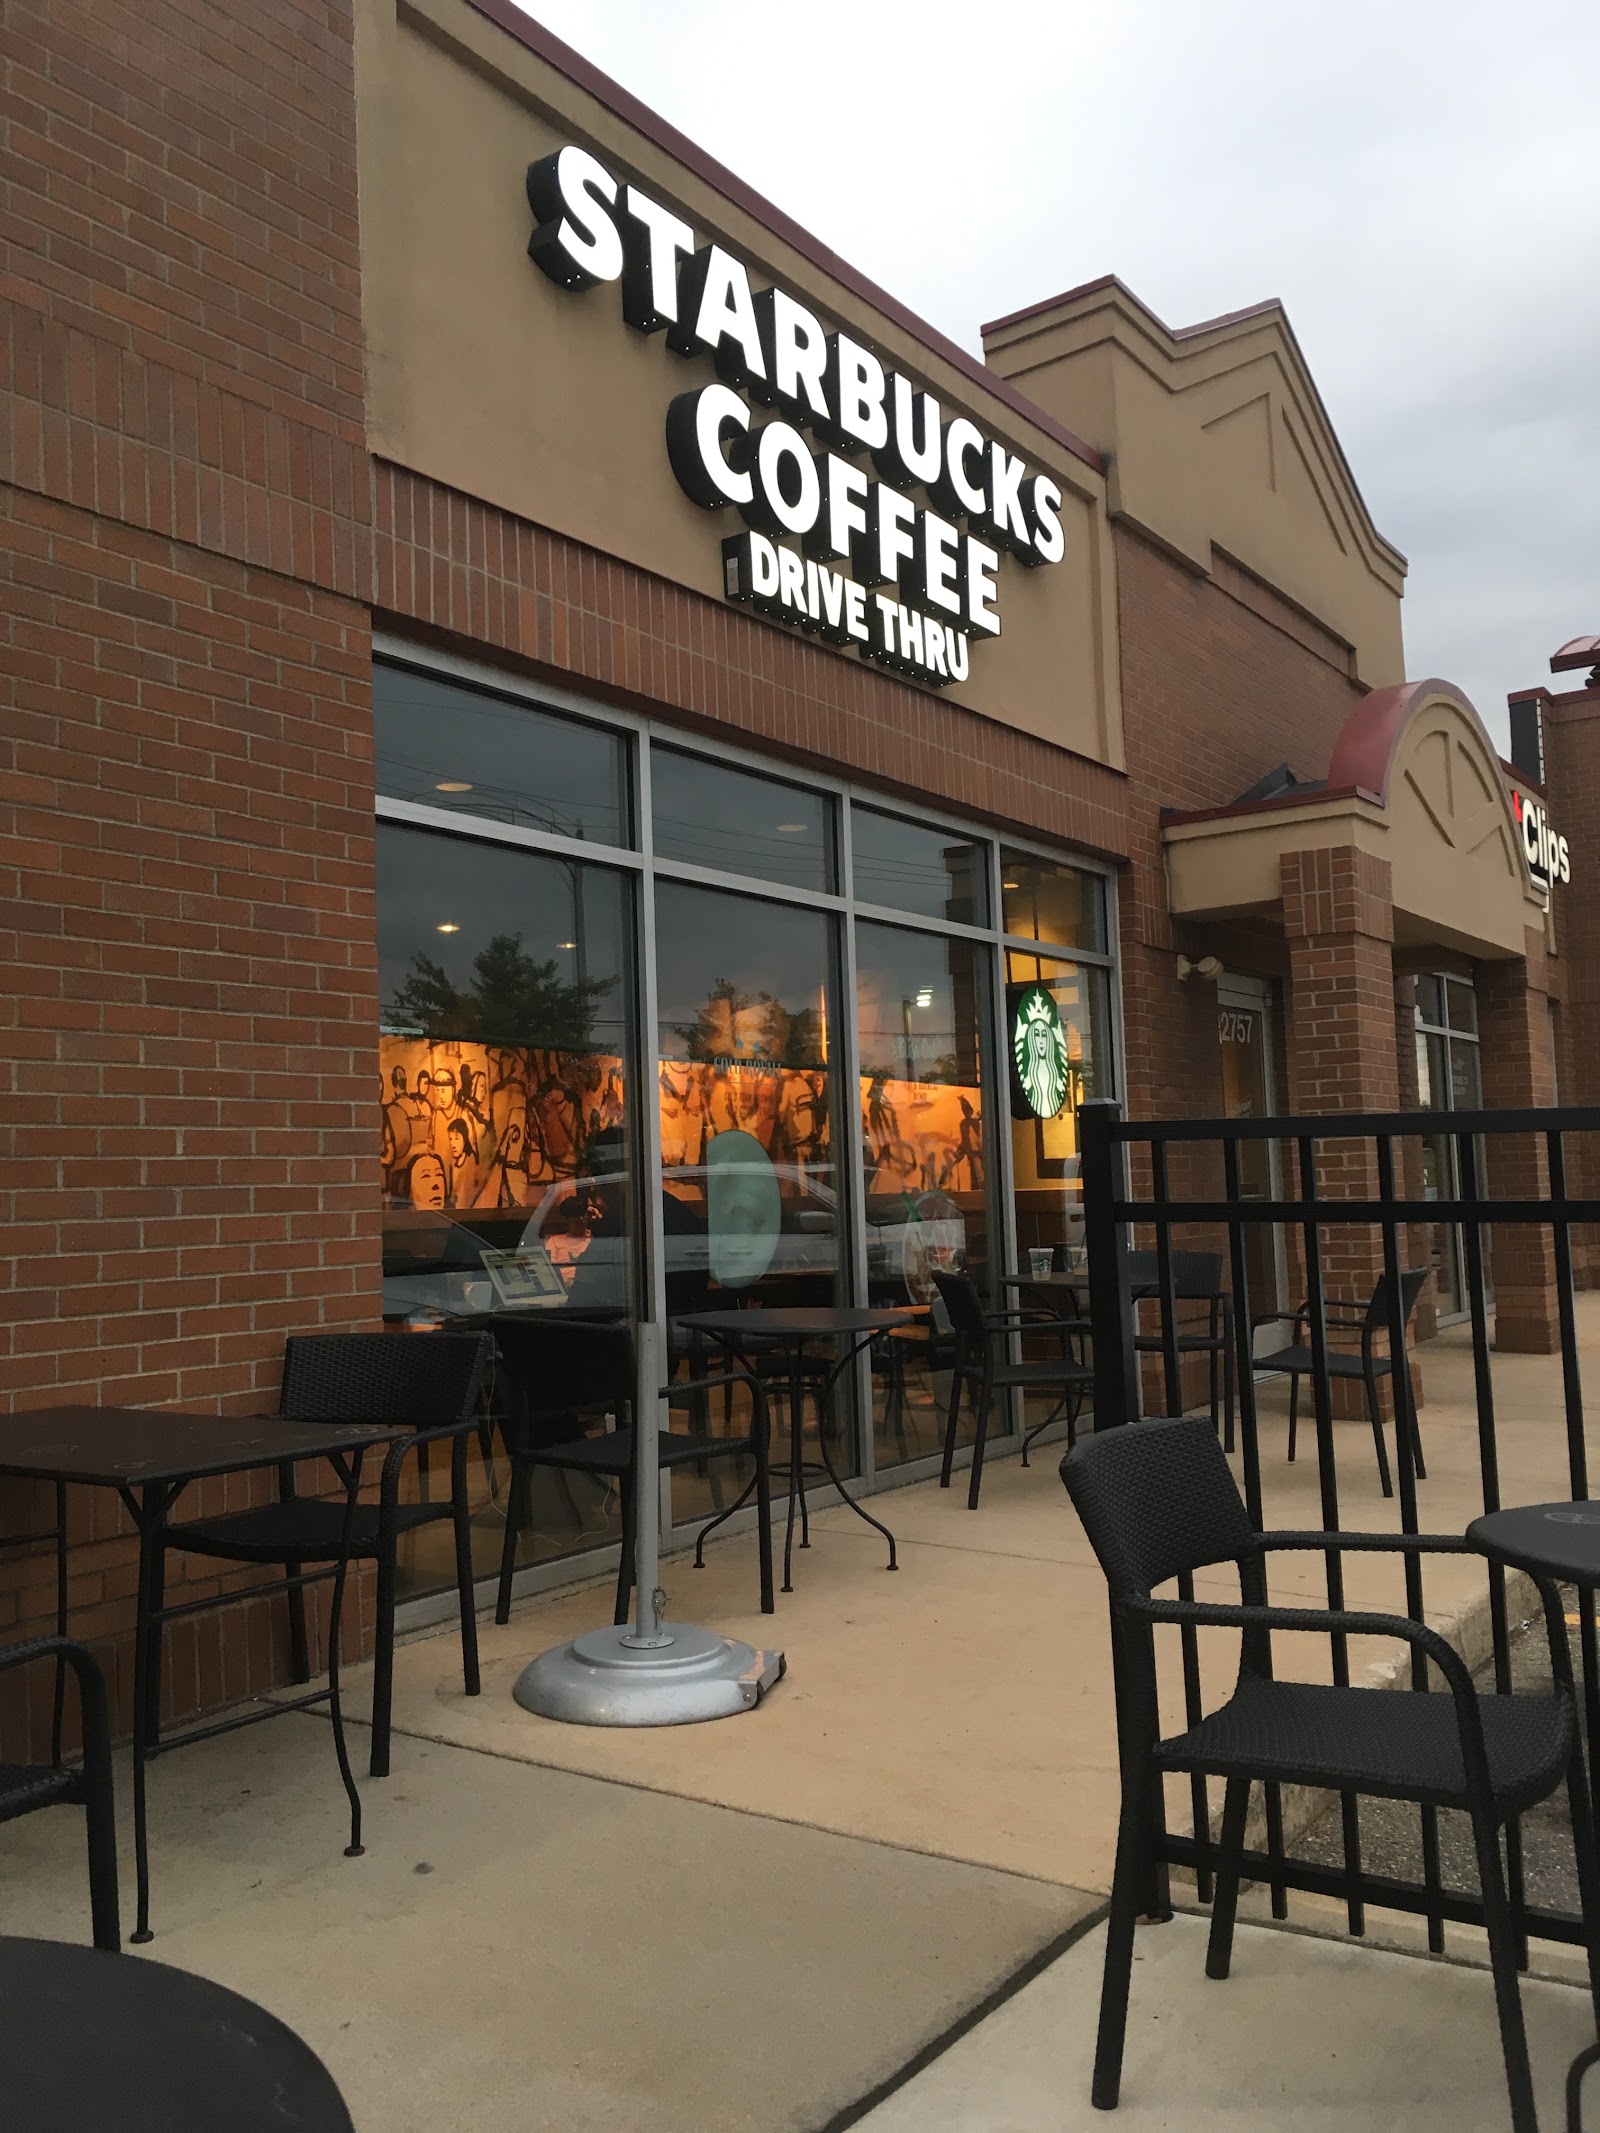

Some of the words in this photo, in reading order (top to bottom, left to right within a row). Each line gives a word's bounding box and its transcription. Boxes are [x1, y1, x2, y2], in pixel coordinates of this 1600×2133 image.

[557, 145, 1065, 564] STARBUCKS
[696, 383, 1001, 637] COFFEE
[749, 530, 869, 642] DRIVE
[876, 593, 970, 682] THRU
[1522, 798, 1571, 889] Clips
[1218, 1011, 1253, 1044] 2757
